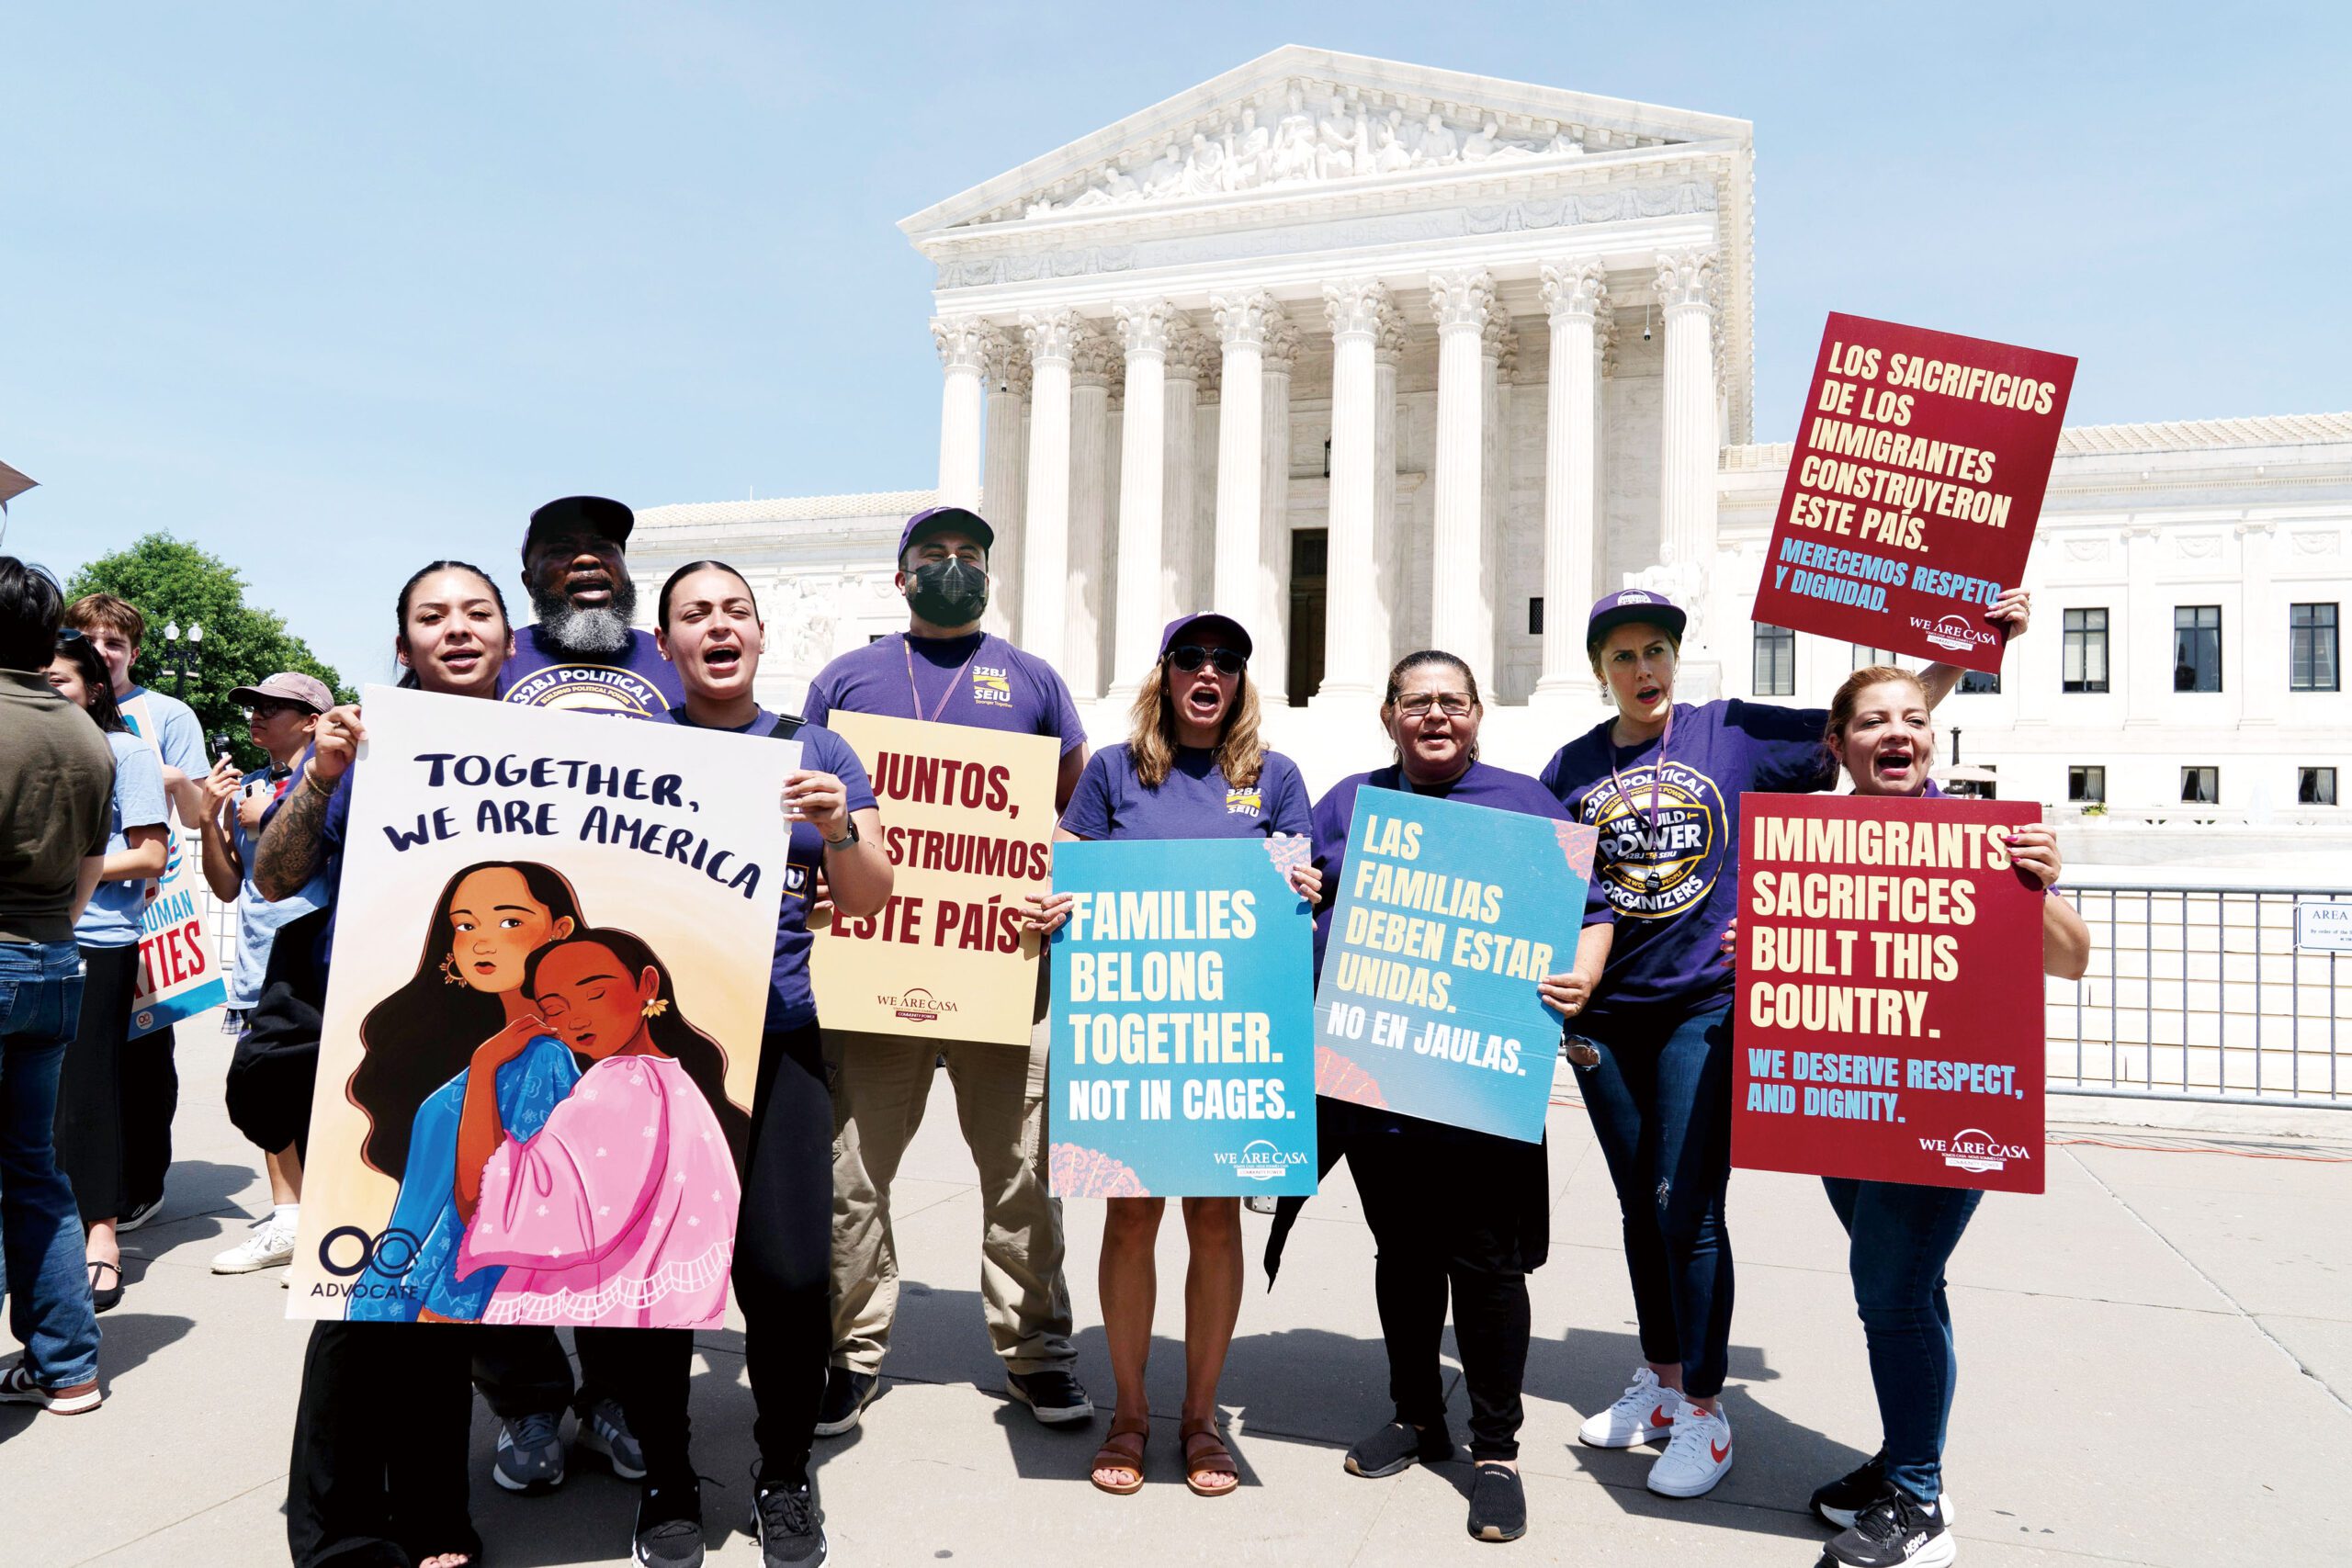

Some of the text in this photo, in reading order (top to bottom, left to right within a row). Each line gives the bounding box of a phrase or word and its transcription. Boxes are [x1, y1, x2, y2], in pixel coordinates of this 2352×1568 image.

[1232, 231, 1308, 255] JUSTICE
[1317, 223, 1396, 246] UNDER
[1817, 379, 1915, 426] DE LOS
[1827, 342, 2056, 414] LOS SACRIFICIOS
[1807, 417, 1996, 484] INMIGRANTES
[1800, 456, 2012, 528] CONSTRUYERON
[1789, 492, 1929, 552] ESTE PAÍS.
[1779, 537, 1909, 587] MERECEMOS
[1775, 565, 1890, 613] Y DIGNIDAD.
[1910, 616, 1996, 646] WE ARE CASA
[513, 669, 653, 705] 32BJ POLITICAL
[572, 685, 607, 695] POLITICAL
[606, 690, 631, 705] POWER
[973, 665, 1007, 677] 32BJ
[974, 689, 1011, 702] SEIU
[413, 753, 699, 813] TOGETHER,
[867, 751, 1020, 819] JUNTOS,
[1227, 787, 1262, 797] 32BJ
[1585, 785, 1617, 819] 32BJ
[1622, 768, 1706, 799] POLTICAL
[1227, 806, 1260, 818] SEIU
[1610, 818, 1637, 834] WE
[383, 807, 460, 852] WE
[476, 800, 560, 836] ARE
[579, 806, 762, 900] AMERICA
[880, 826, 1048, 882] STRUIMOS
[1363, 814, 1423, 861] LAS
[1599, 824, 1702, 861] POWER
[1658, 851, 1677, 859] SEIU
[1070, 890, 1257, 941] FAMILIES
[1353, 860, 1503, 924] FAMILIAS
[1601, 874, 1703, 911] ORGANIZERS
[1752, 871, 1976, 925] SACRIFICES
[2312, 909, 2348, 919] AREA
[933, 894, 1022, 954] PAÍS
[1344, 906, 1553, 982] DEBEN ESTAR
[135, 919, 206, 999] TIES
[1070, 951, 1224, 1002] BELONG
[1752, 926, 1959, 982] BUILT THIS
[877, 995, 898, 1006] WE
[900, 998, 926, 1009] ARE
[927, 999, 957, 1011] CASA
[1337, 952, 1456, 1014] UNIDAS.
[1749, 981, 1940, 1039] COUNTRY.
[1069, 1012, 1283, 1065] TOGETHER.
[1327, 1001, 1526, 1076] NO EN JAULAS.
[1748, 1048, 2023, 1100] WE DESERVE RESPECT,
[1069, 1078, 1295, 1121] NOT IN CAGES.
[1747, 1083, 1905, 1123] AND DIGNITY.
[1214, 1152, 1308, 1165] WE ARE CASA
[1918, 1138, 2030, 1159] WE ARE CASA
[311, 1282, 419, 1300] ADVOCATE
[1902, 1530, 1928, 1560] HOKA
